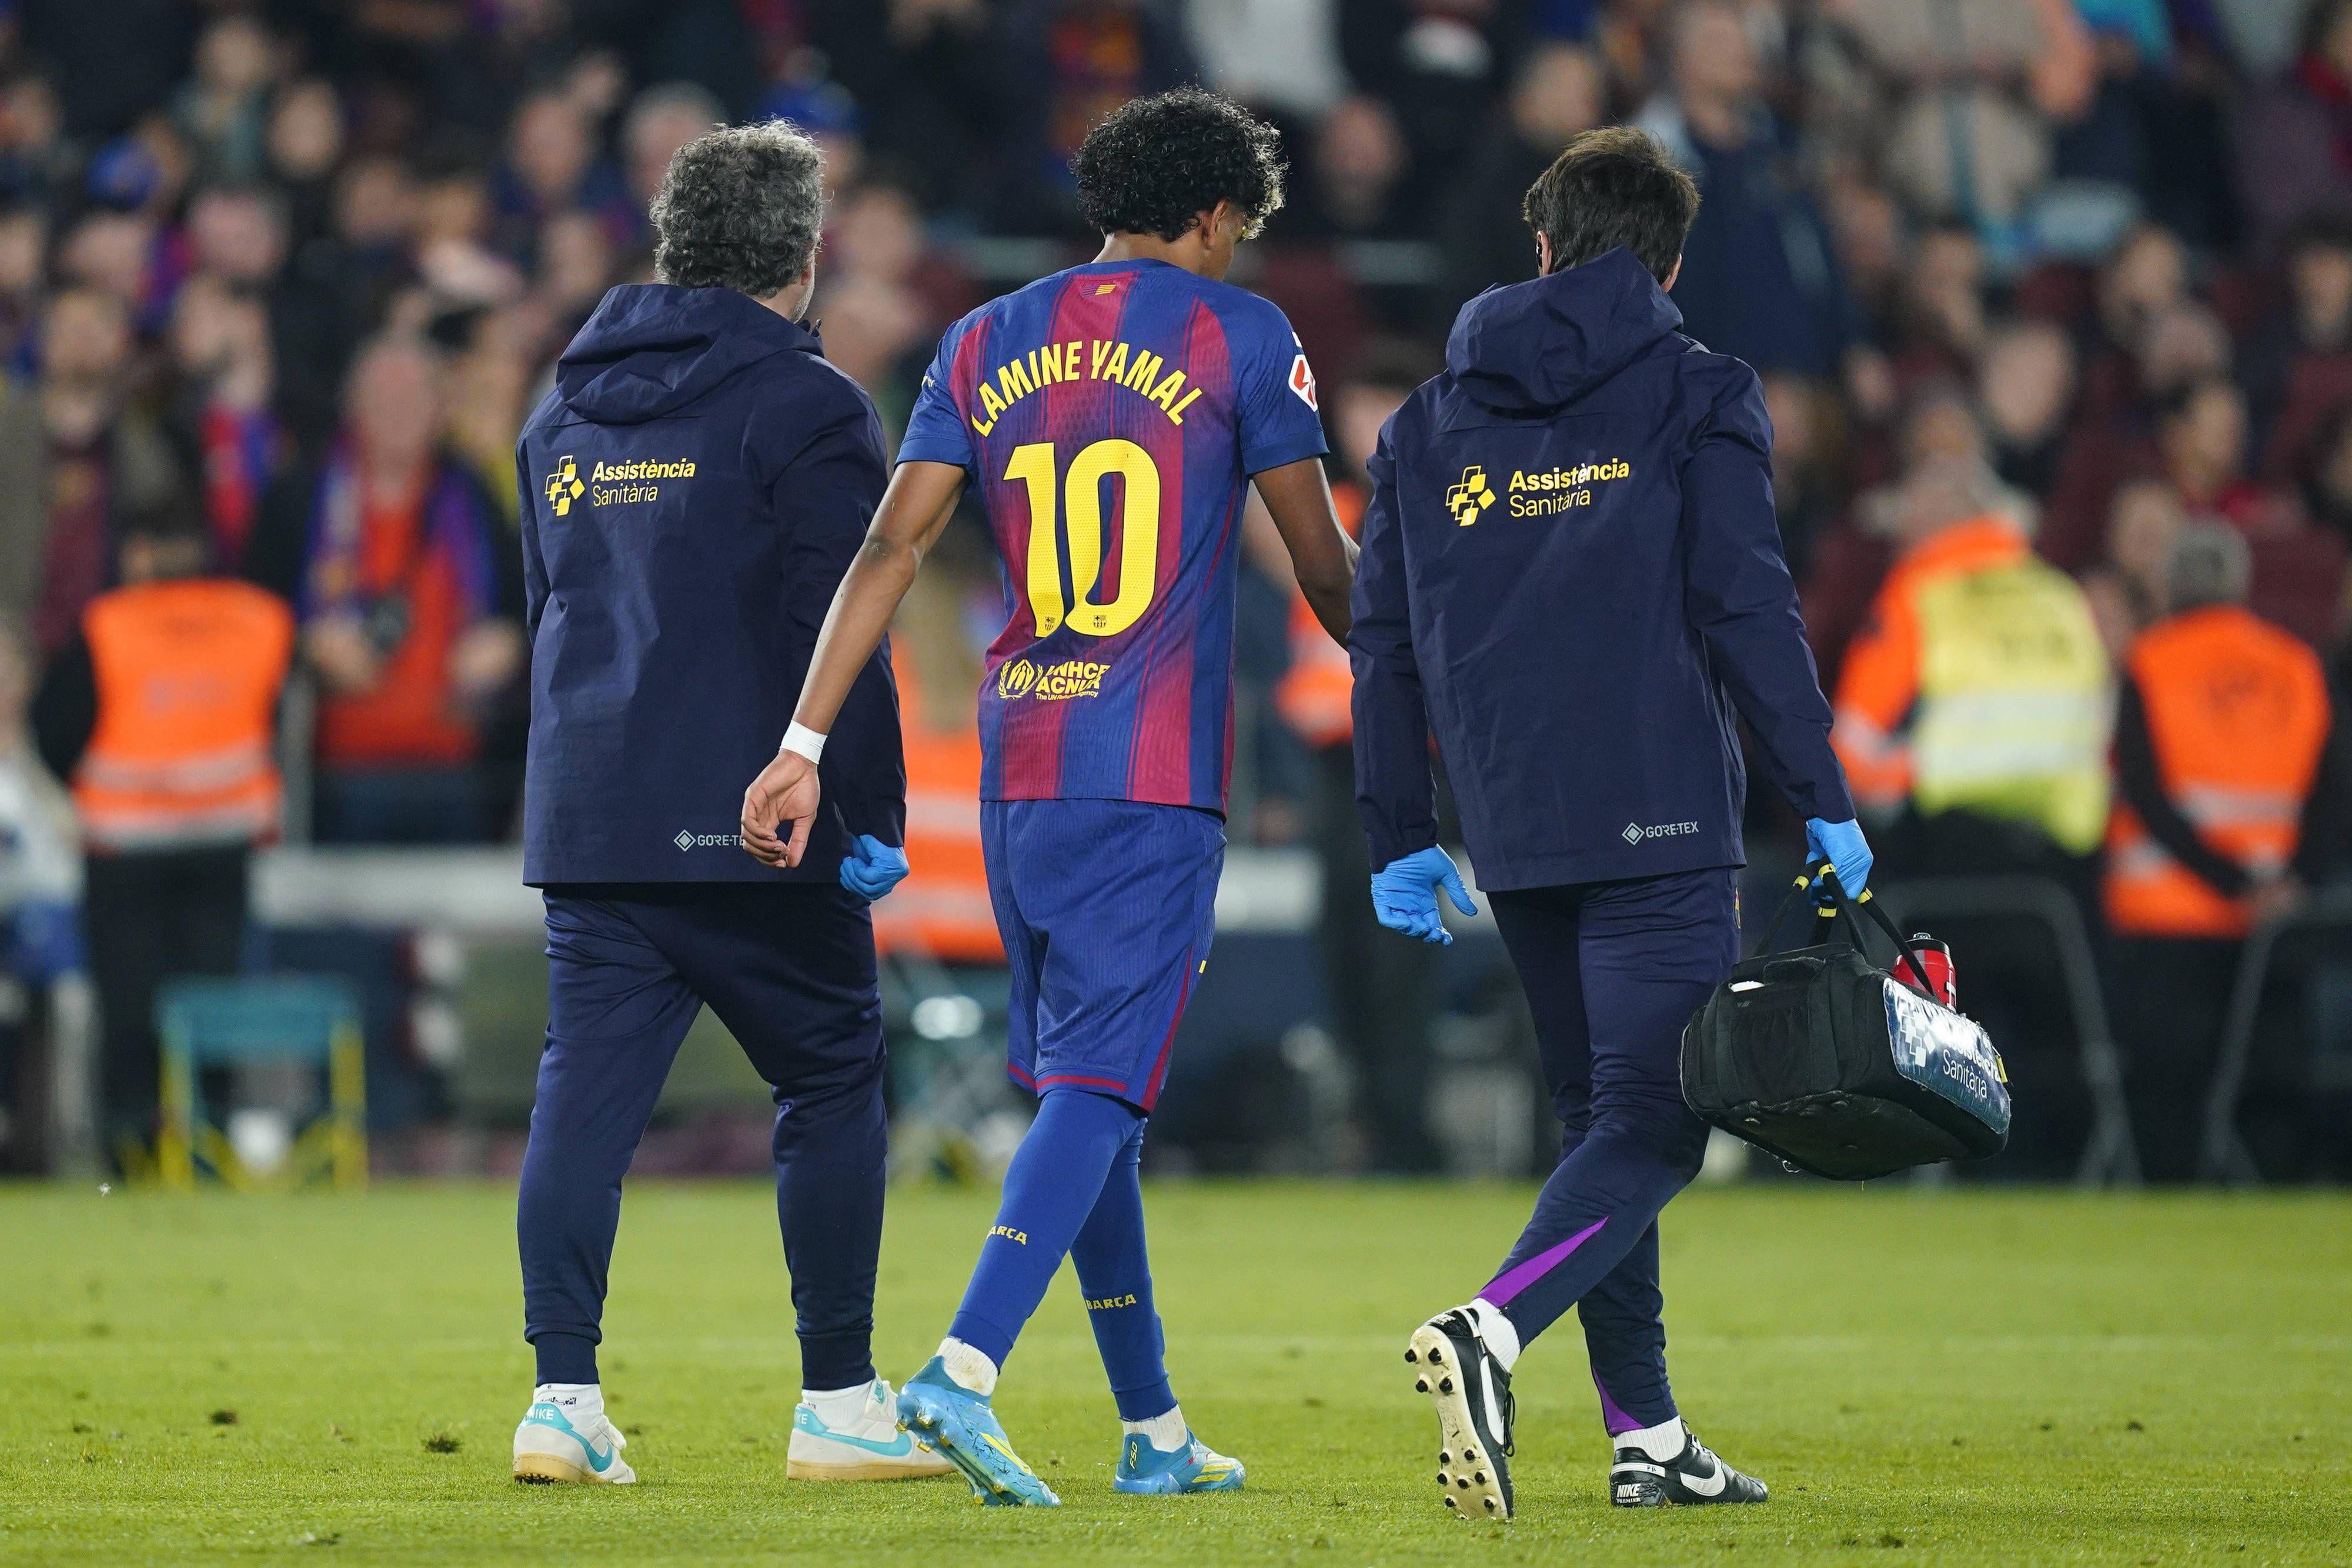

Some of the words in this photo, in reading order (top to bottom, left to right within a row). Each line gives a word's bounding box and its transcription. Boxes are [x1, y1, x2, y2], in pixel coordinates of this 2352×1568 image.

[971, 340, 1083, 436] LAMINE
[1091, 339, 1202, 426] YAMAL
[591, 457, 696, 483] Assistència
[1508, 457, 1630, 492] Assistència
[593, 482, 659, 507] Sanitària
[1509, 486, 1591, 517] Sanitària
[1003, 439, 1161, 638] 10
[698, 834, 743, 847] GORE-TE
[1646, 821, 1699, 838] GORE-TEX
[1943, 1048, 1987, 1099] Sanitària
[987, 1226, 1027, 1245] ARÇA
[1616, 1483, 1641, 1497] NIKE
